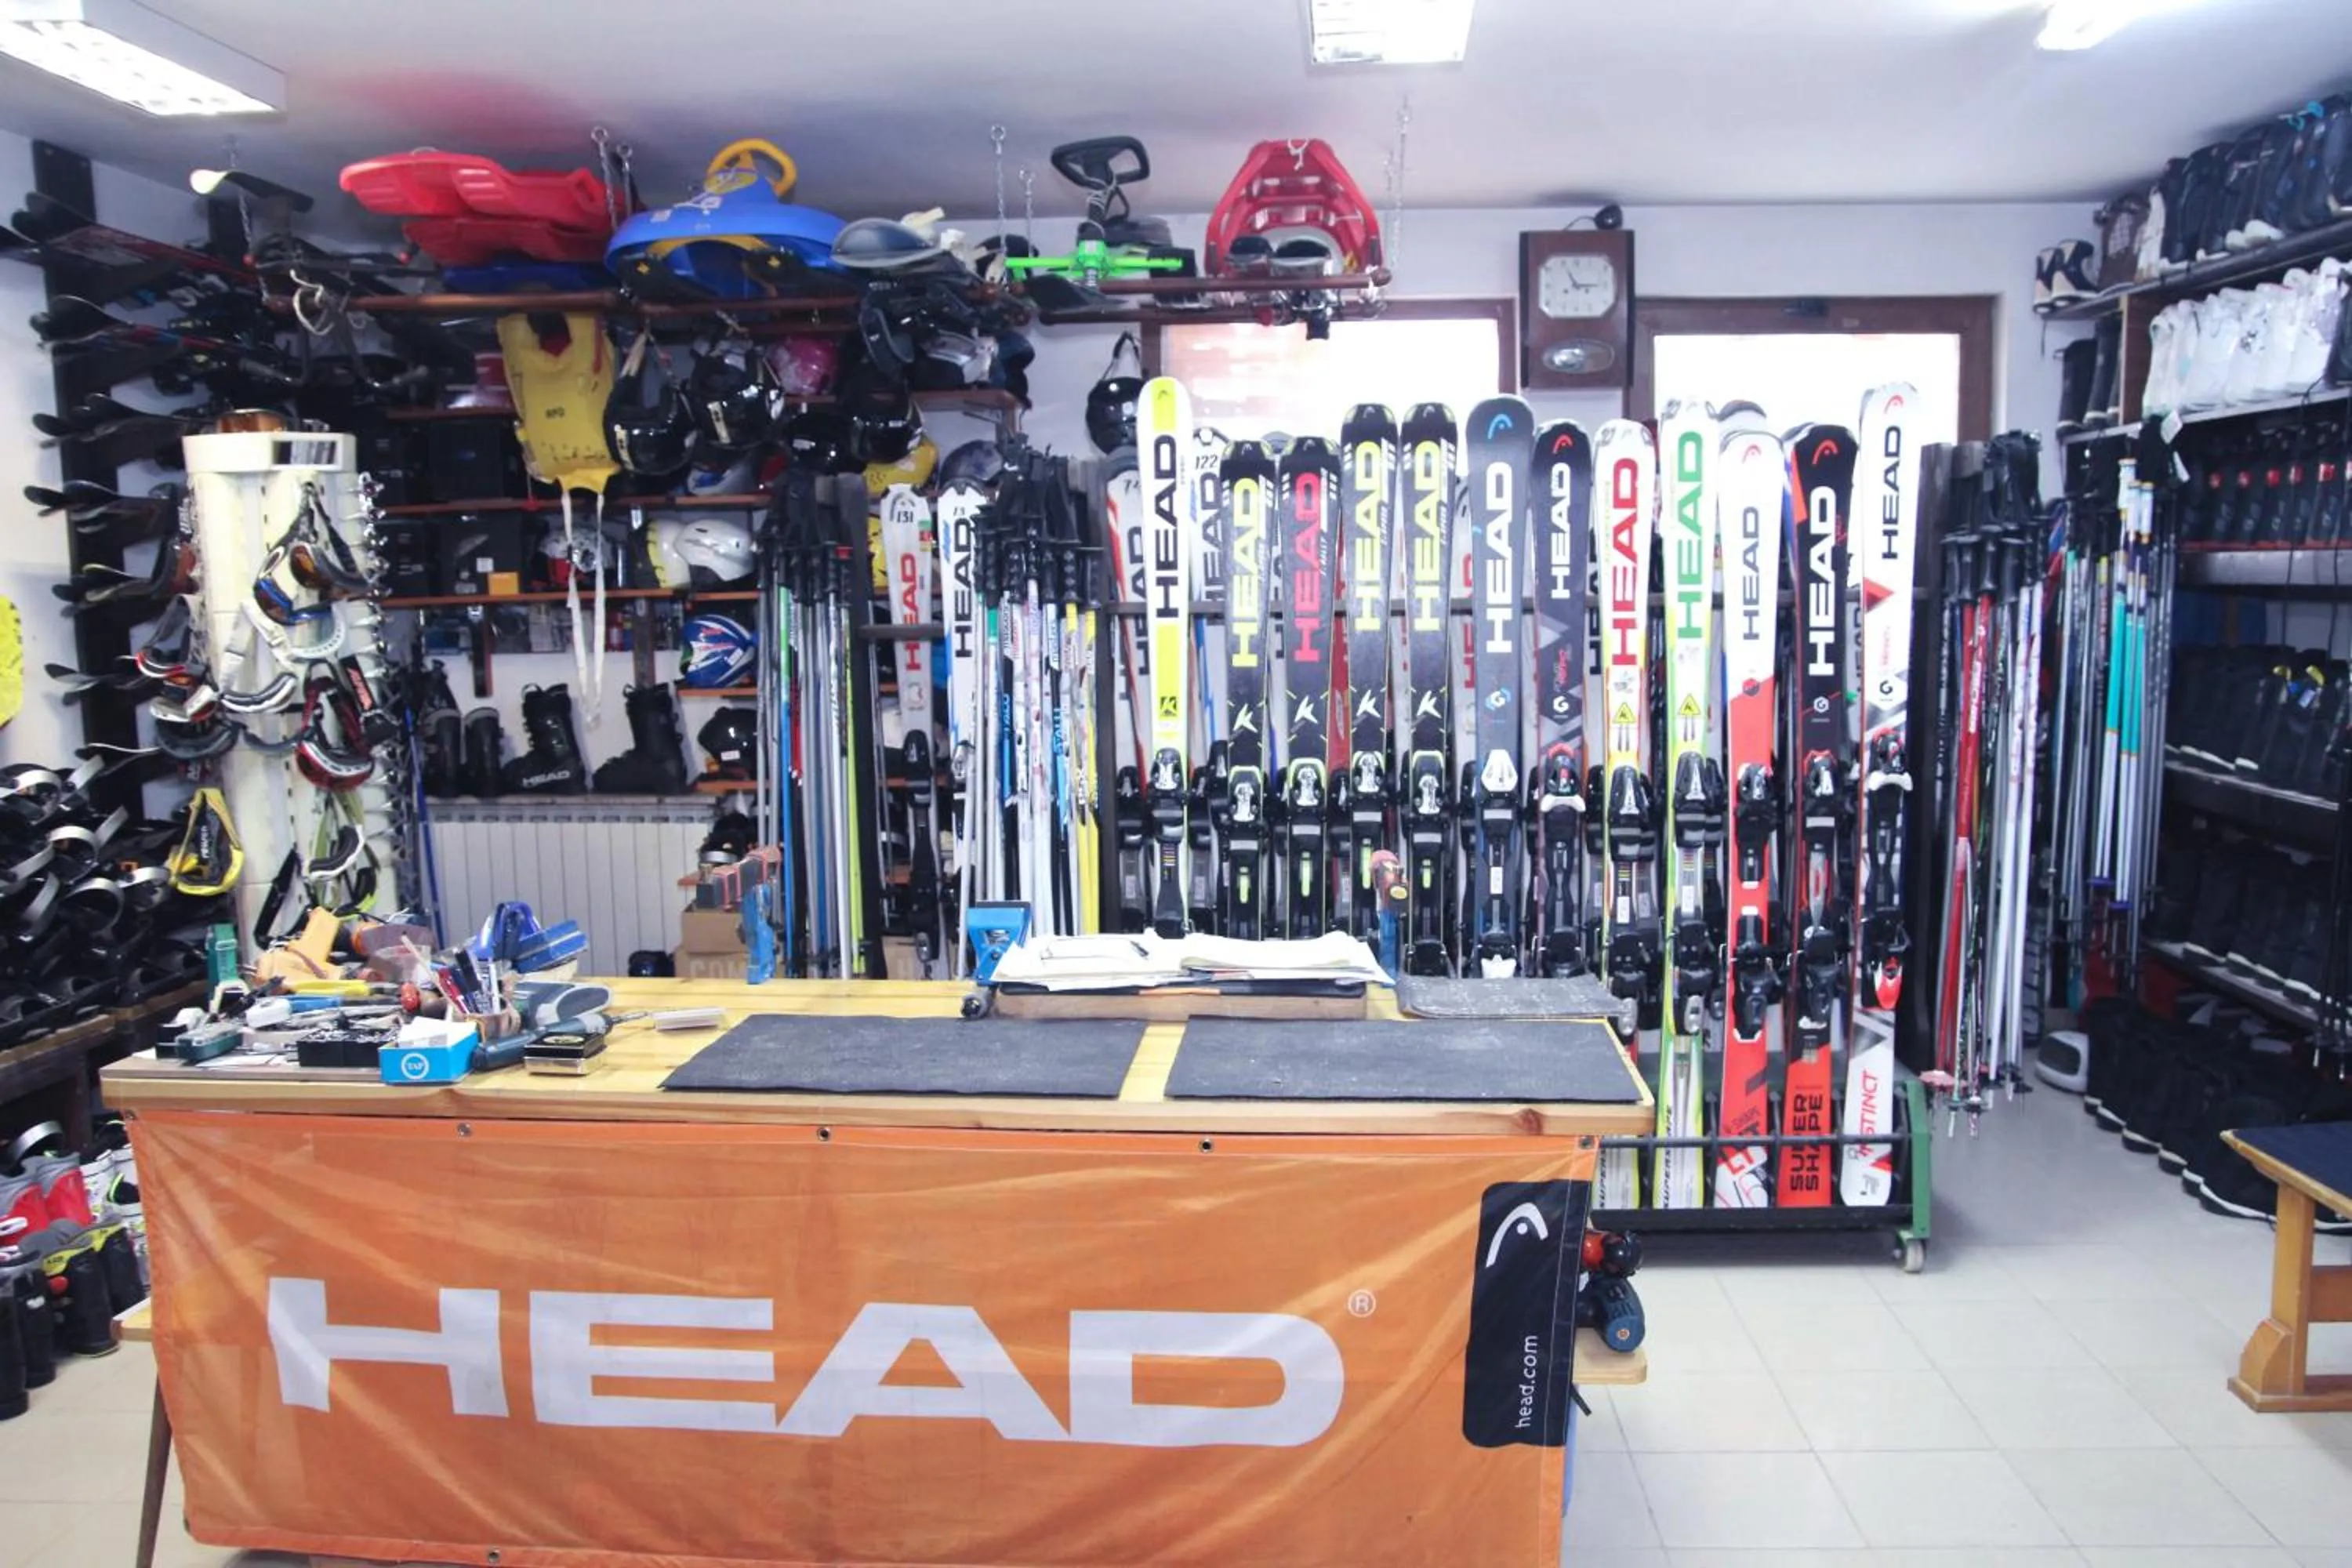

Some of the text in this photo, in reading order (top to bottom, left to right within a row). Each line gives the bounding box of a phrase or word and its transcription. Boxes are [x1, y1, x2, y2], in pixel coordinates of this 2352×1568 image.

[897, 510, 914, 523] 131
[1154, 434, 1178, 619] HEAD
[1196, 456, 1219, 470] 122
[1356, 441, 1381, 632] HEAD
[1414, 441, 1441, 632] HEAD
[1551, 463, 1570, 600] HEAD
[1678, 431, 1703, 639] HEAD
[1882, 425, 1901, 560] HEAD
[954, 518, 973, 658] HEAD
[1232, 477, 1258, 668] HEAD
[1295, 472, 1321, 662] HEAD
[1486, 462, 1513, 653] HEAD
[1612, 458, 1639, 666] HEAD
[1743, 506, 1760, 641] HEAD
[1809, 486, 1837, 677] HEAD
[522, 770, 571, 788] HEAD
[267, 1276, 1344, 1447] HEAD
[1515, 1334, 1538, 1428] head.com
